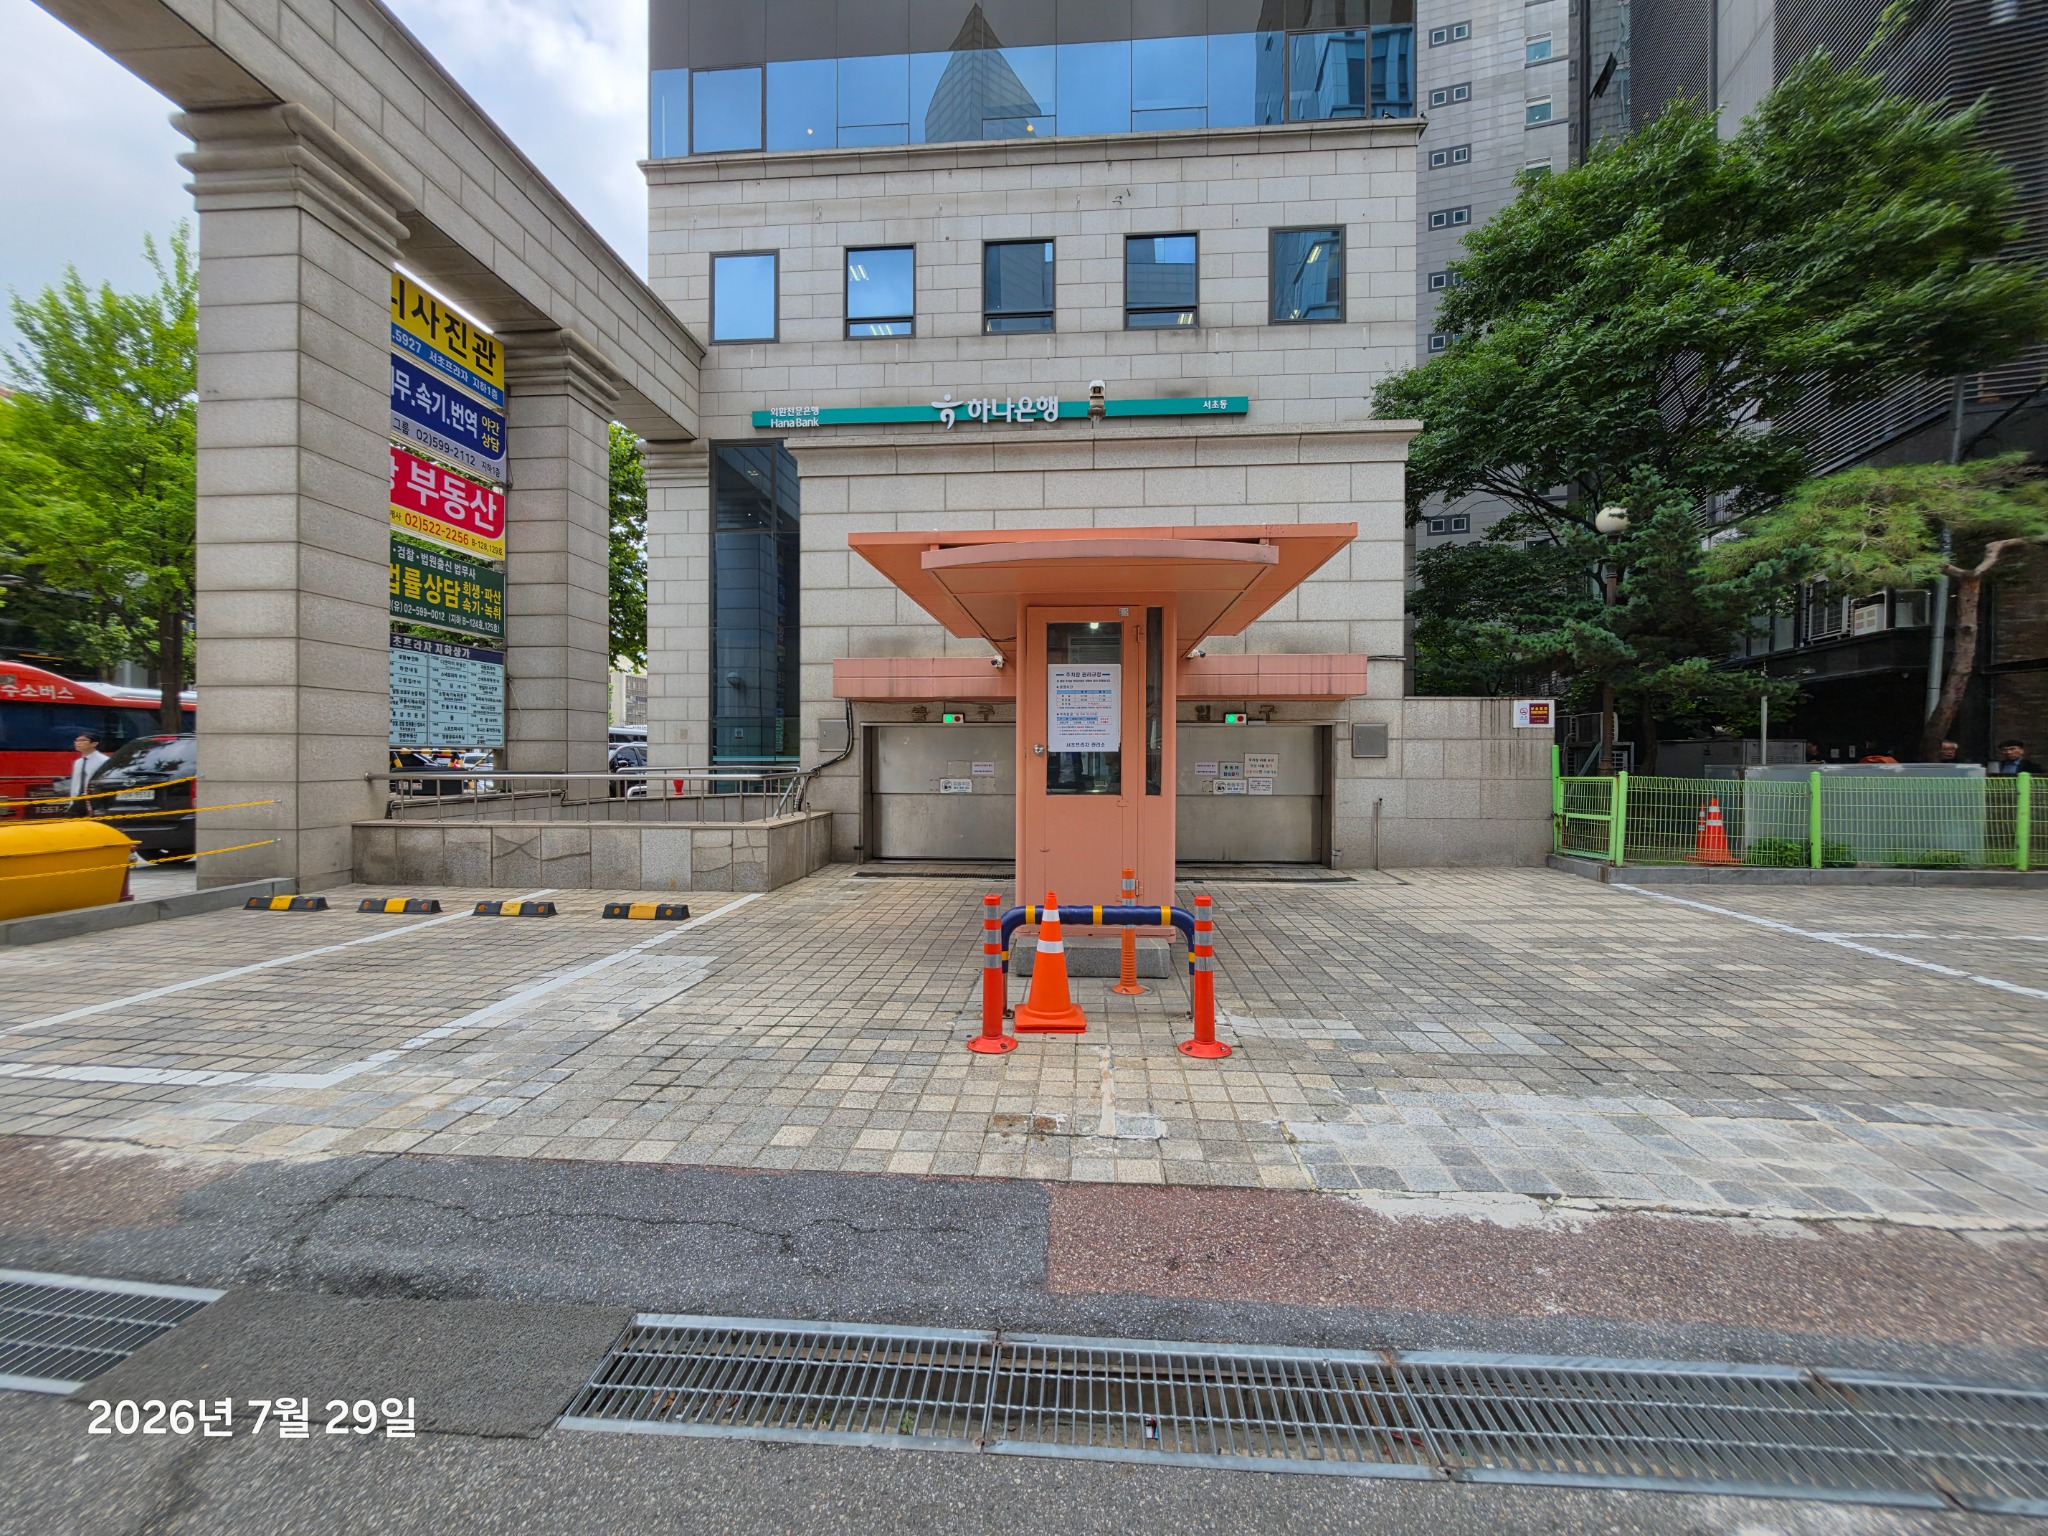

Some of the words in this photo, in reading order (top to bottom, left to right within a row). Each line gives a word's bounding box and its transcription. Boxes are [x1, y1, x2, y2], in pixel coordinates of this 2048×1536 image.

[429, 350, 469, 382] 서초프라자
[472, 377, 499, 400] 지하1층
[770, 406, 820, 417] 외환전문은행
[967, 395, 1059, 423] 하나은행
[1203, 399, 1228, 410] 서초동
[481, 416, 500, 437] 야간
[770, 418, 795, 428] Hana
[796, 417, 820, 427] Bank
[481, 432, 500, 453] 상담
[416, 429, 476, 466] 02)599-2112
[481, 460, 501, 478] 지하1층
[407, 460, 497, 531] 부동산
[404, 513, 469, 545] 02)522-2256
[471, 539, 503, 556] B-128,129호
[454, 563, 477, 580] 법무사
[403, 603, 445, 620] 02-599-0012
[435, 643, 471, 659] 지하상가
[0, 684, 75, 700] 수소버스
